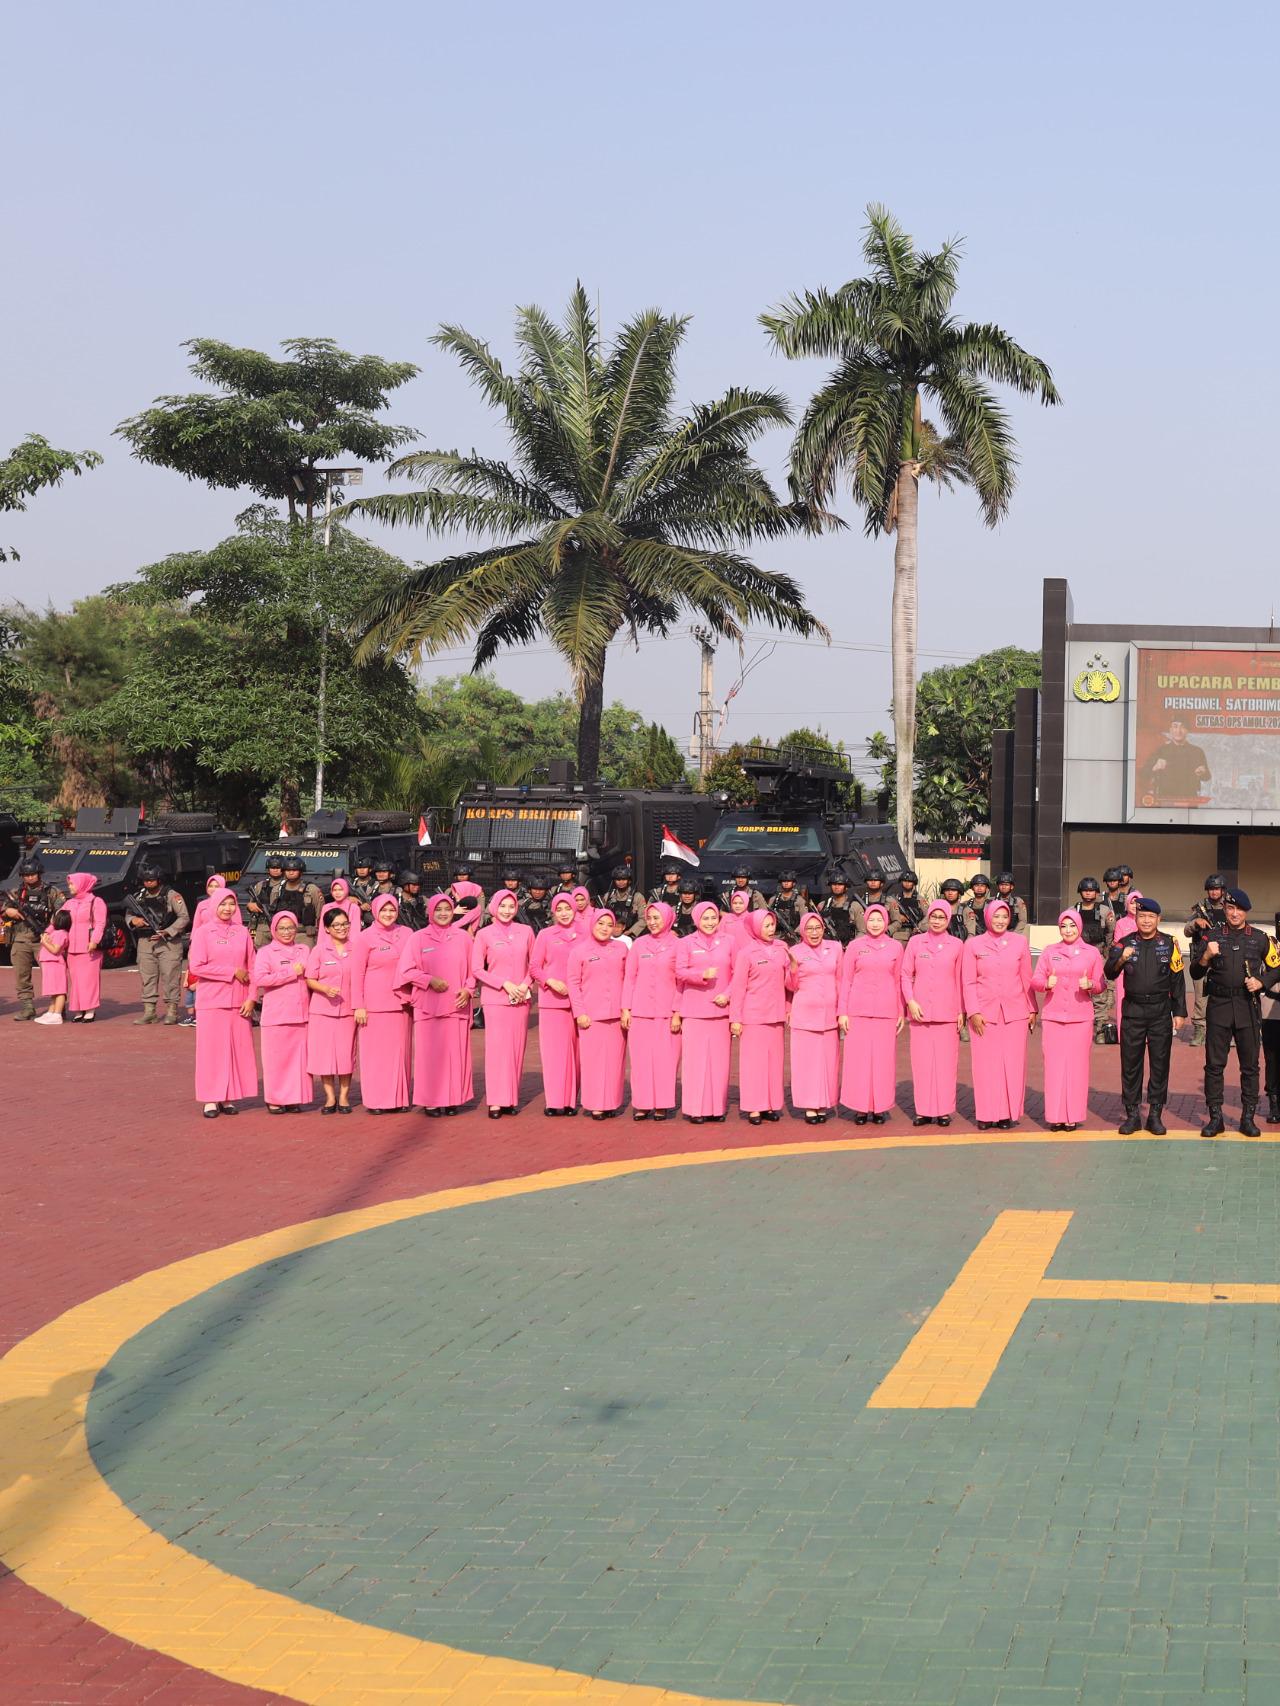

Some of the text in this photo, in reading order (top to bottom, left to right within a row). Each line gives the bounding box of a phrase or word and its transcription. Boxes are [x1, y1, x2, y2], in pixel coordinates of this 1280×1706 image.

[1157, 675, 1233, 689] UPACARA
[1164, 697, 1222, 710] PERSONEL
[1196, 715, 1225, 728] SATGAS
[1227, 716, 1242, 728] OPS
[465, 808, 578, 821] KORPS BRIMOB
